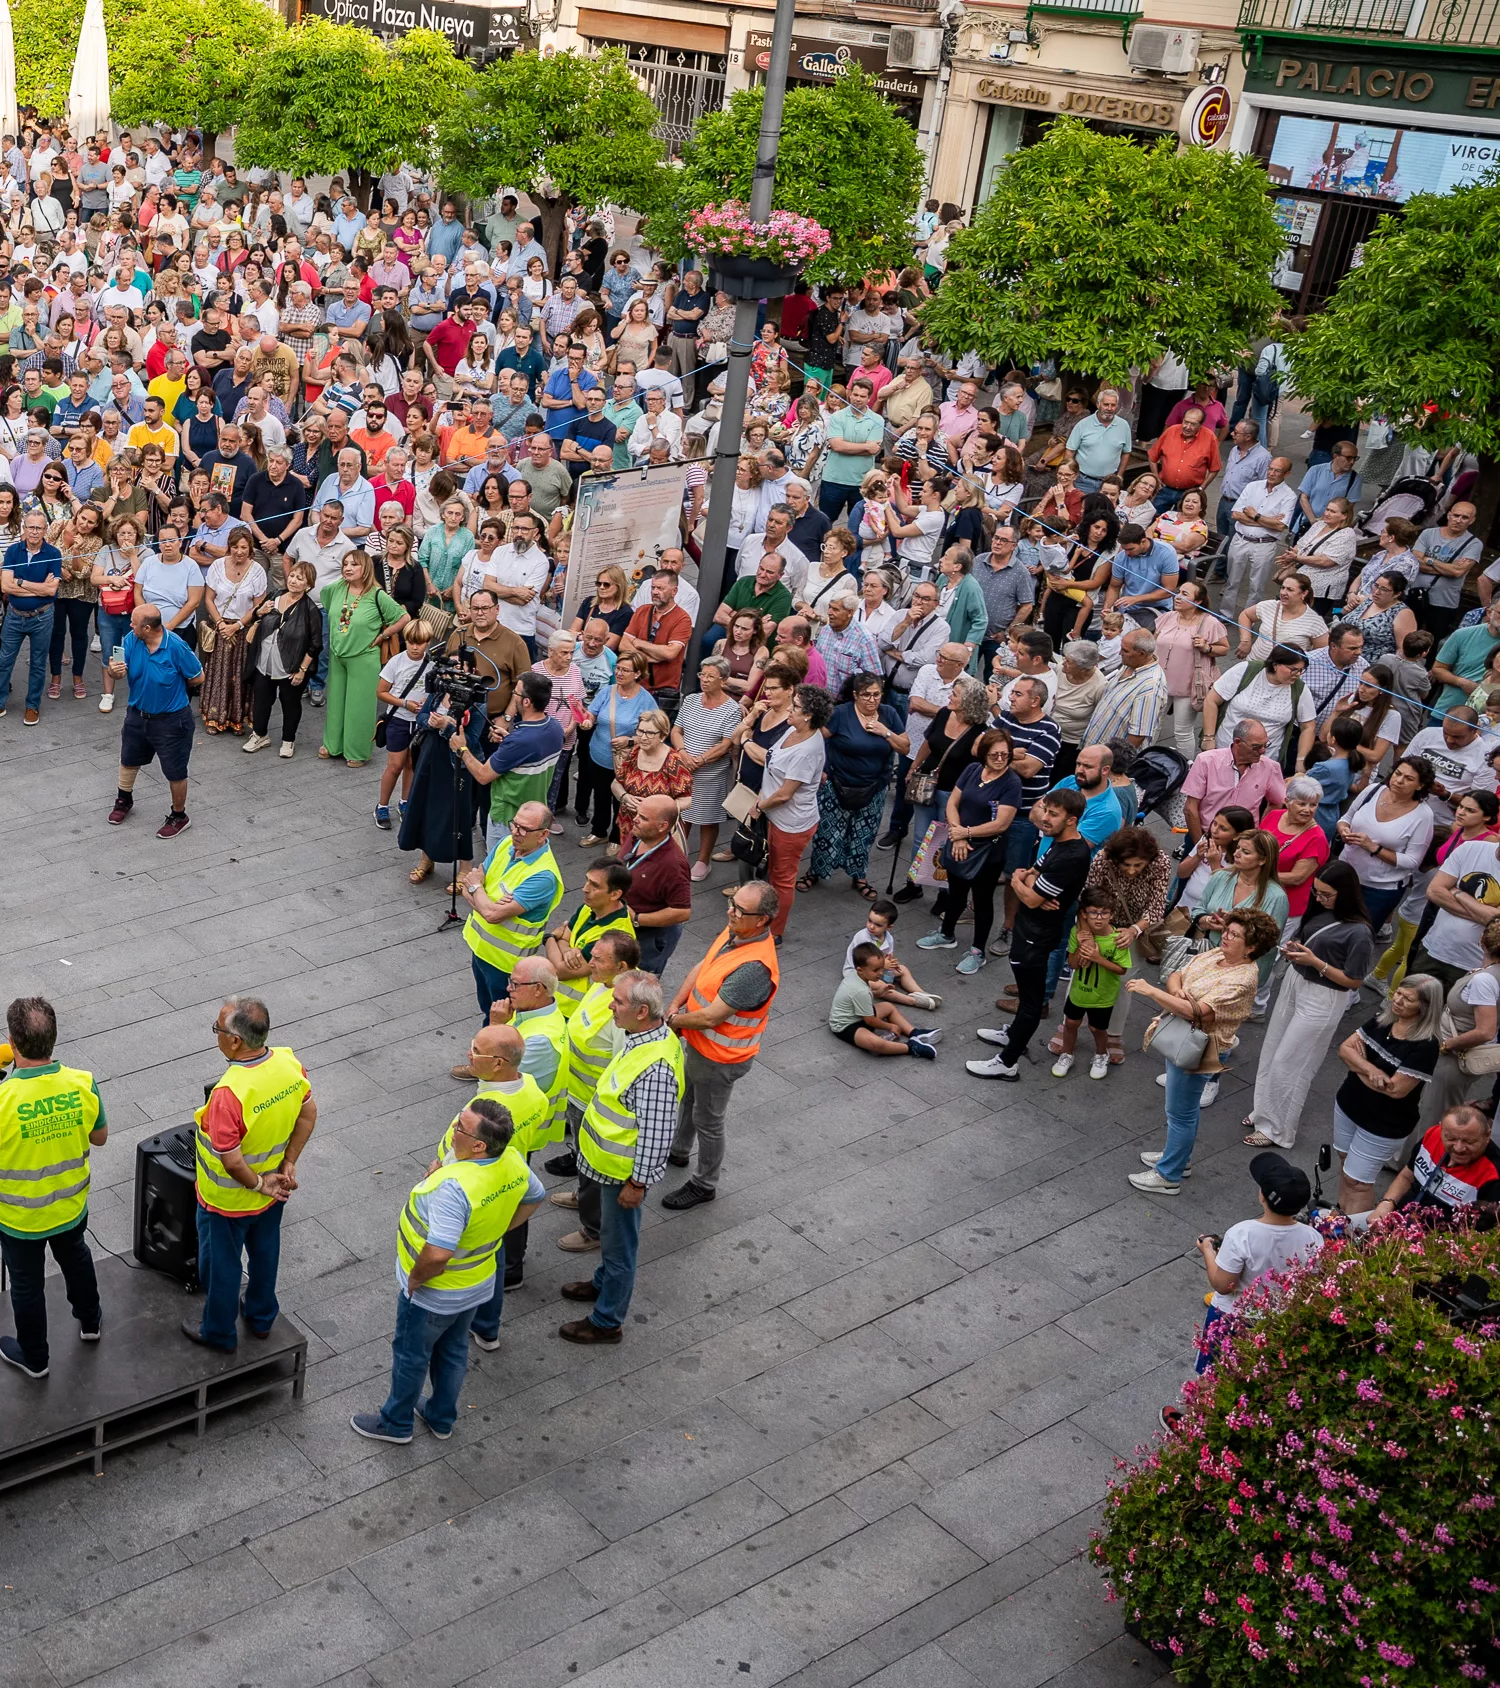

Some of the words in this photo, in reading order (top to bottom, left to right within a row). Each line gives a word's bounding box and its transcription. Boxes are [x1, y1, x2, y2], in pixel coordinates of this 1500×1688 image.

[373, 0, 415, 28] Plaza
[420, 4, 474, 38] Nueva
[730, 54, 739, 63] 18
[874, 78, 918, 94] nadería
[1275, 59, 1434, 102] PALACIO
[976, 78, 1051, 105] Calzado
[1059, 92, 1175, 125] JOYEROS
[1462, 163, 1476, 171] DE
[256, 358, 285, 366] SURVIVOR
[3, 427, 24, 436] LVE
[579, 492, 592, 531] 5
[594, 505, 602, 514] de
[601, 500, 617, 516] junio
[1422, 752, 1462, 773] adidas
[17, 1090, 83, 1122] SATSE
[25, 1115, 67, 1132] SINDICATO
[69, 1110, 80, 1121] DE
